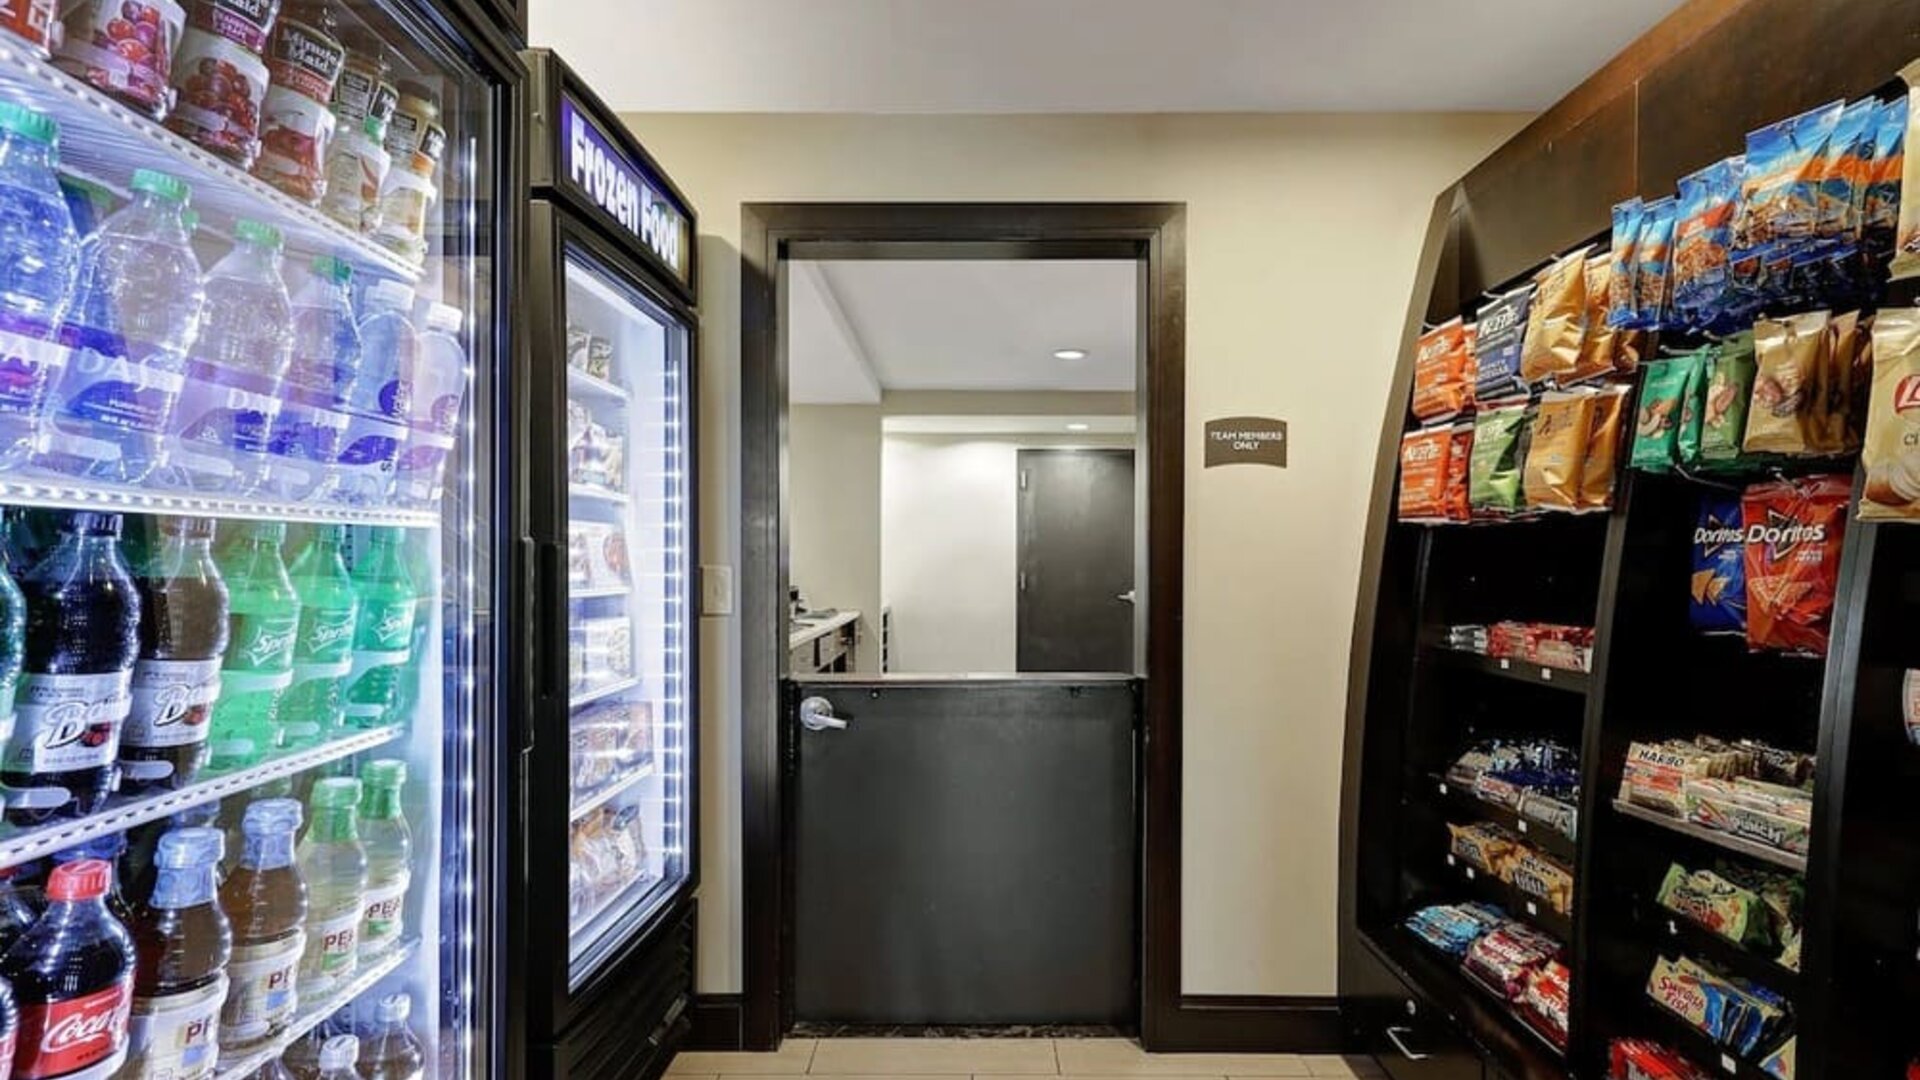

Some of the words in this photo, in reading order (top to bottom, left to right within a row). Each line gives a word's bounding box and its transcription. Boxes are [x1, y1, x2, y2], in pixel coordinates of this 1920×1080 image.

[570, 110, 640, 237] Frozen
[641, 182, 679, 268] Food
[1211, 431, 1237, 440] TEAM
[1239, 431, 1282, 440] MEMBERS
[1233, 441, 1260, 450] ONLY
[1694, 527, 1744, 544] Doritos
[1747, 523, 1826, 543] Doritos
[1639, 750, 1685, 767] HARIBO
